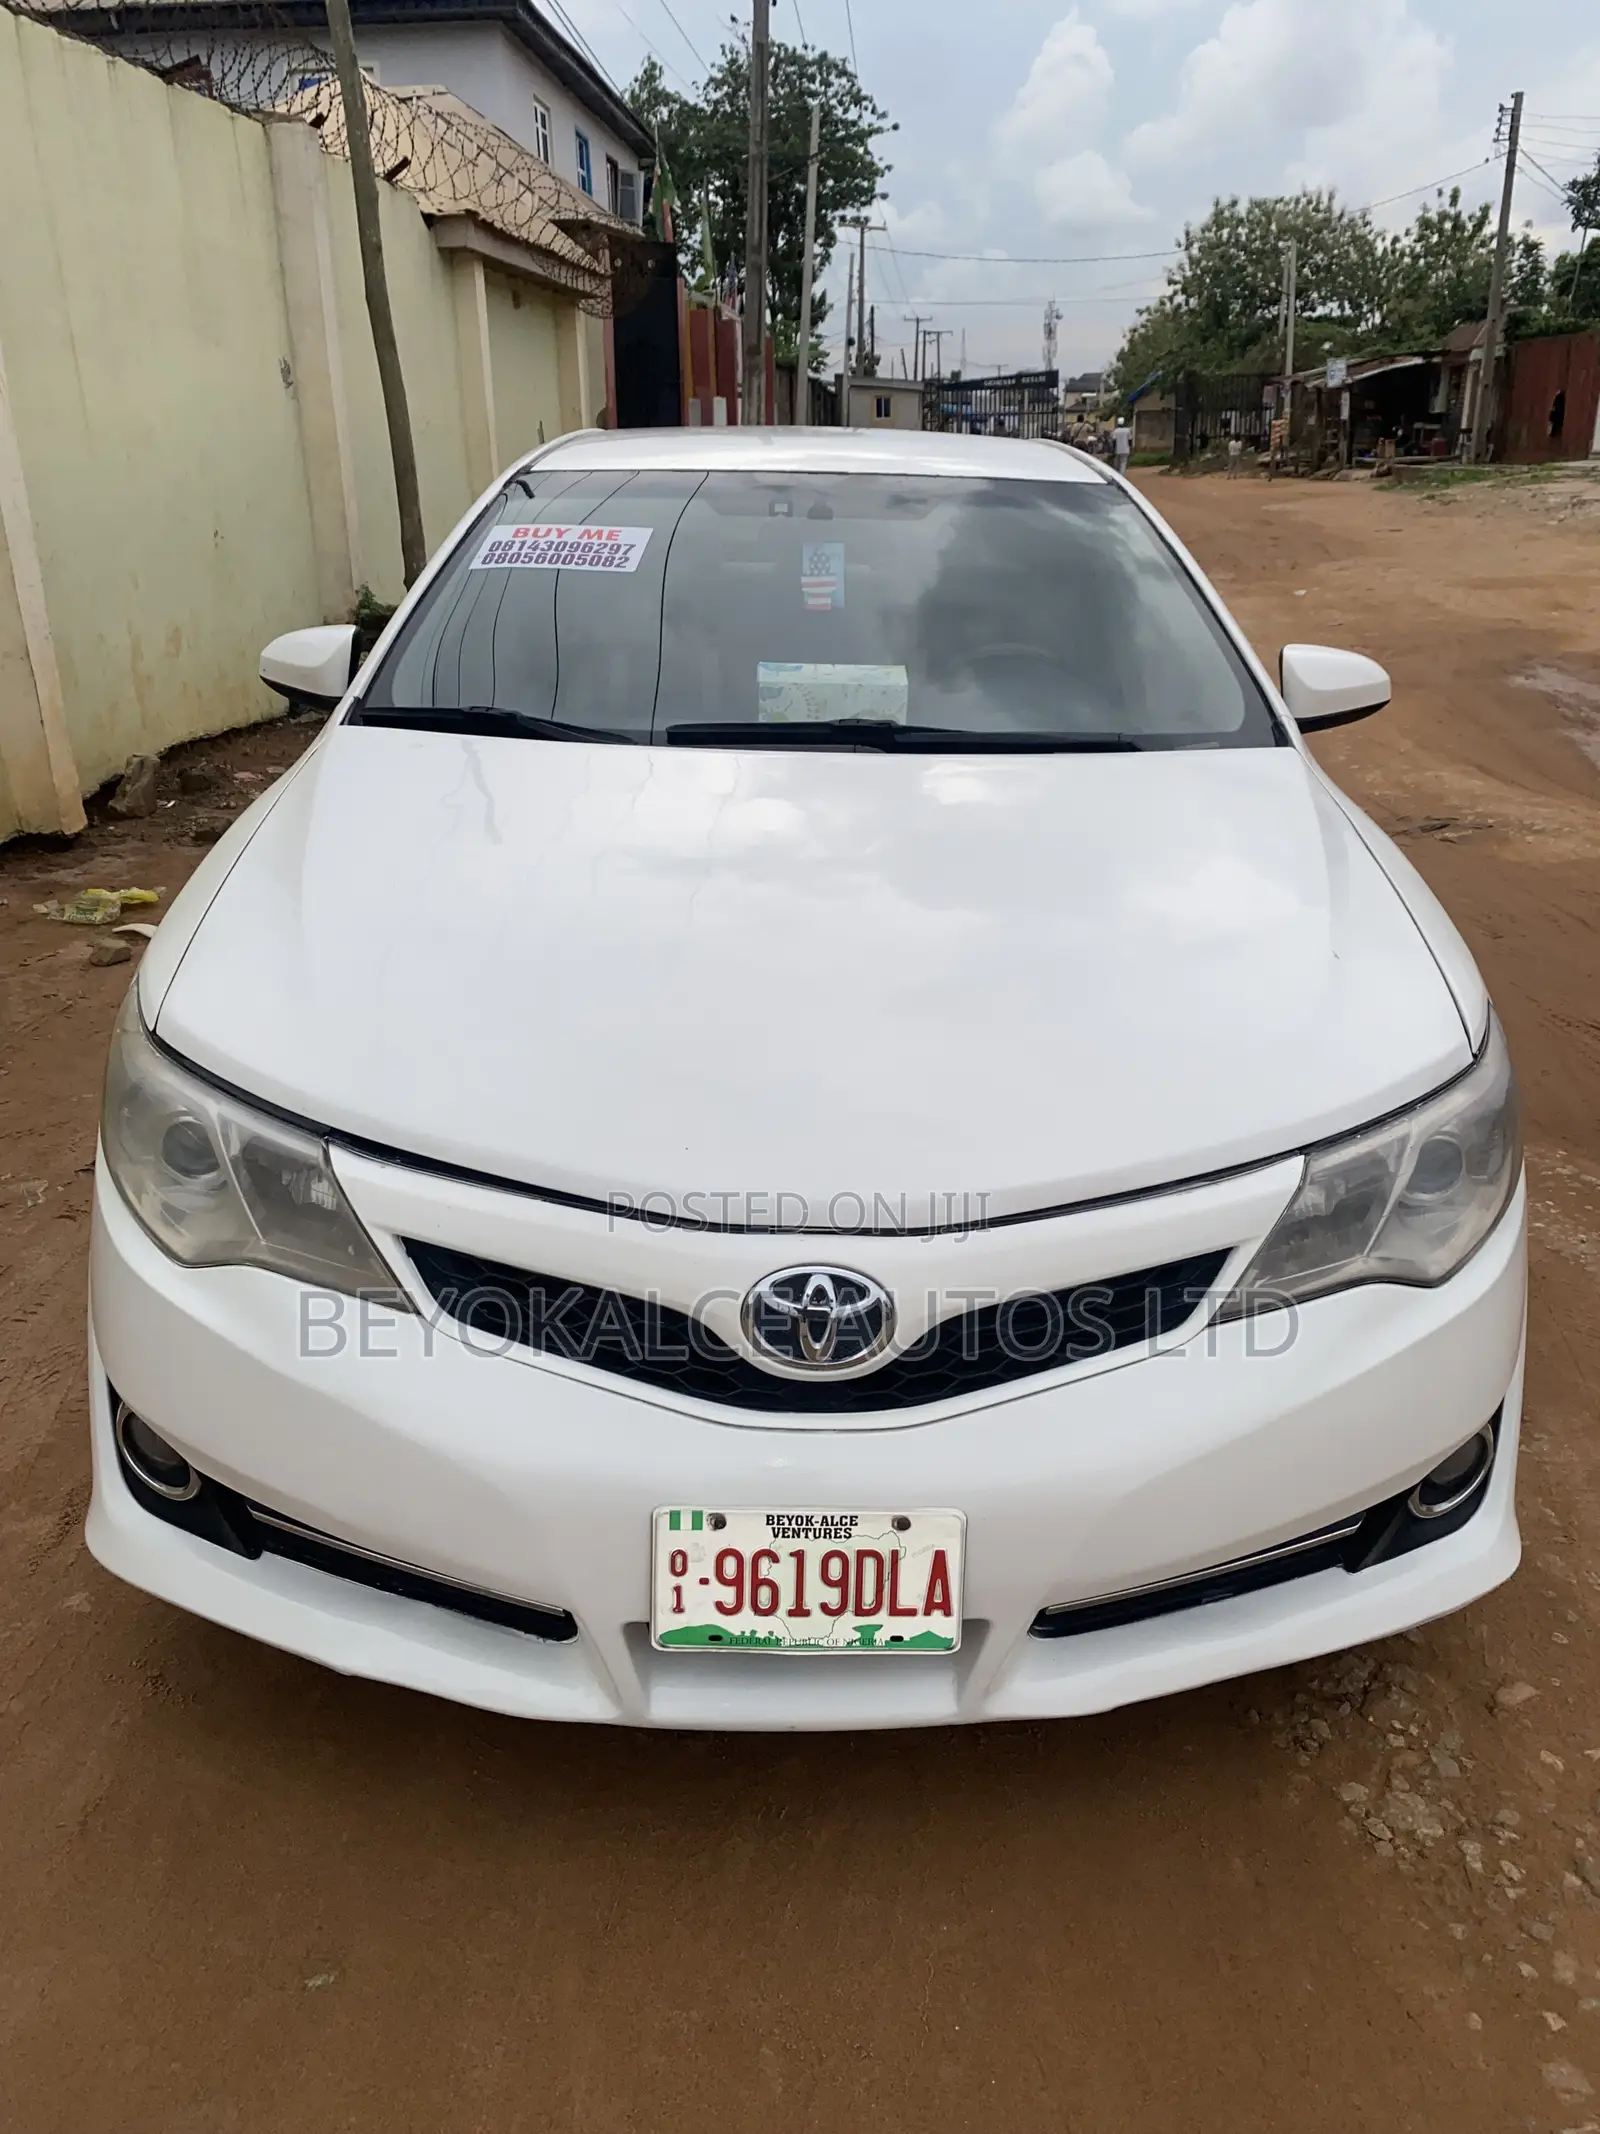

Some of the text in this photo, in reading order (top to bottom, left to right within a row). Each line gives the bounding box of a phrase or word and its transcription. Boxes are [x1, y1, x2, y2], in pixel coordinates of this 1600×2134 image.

[512, 527, 622, 541] BUY ME
[488, 540, 636, 555] 08143096297
[481, 552, 630, 569] 08056005082
[765, 1514, 859, 1527] BEYOK-ALCE
[771, 1527, 852, 1540] VENTURES
[729, 1637, 886, 1646] FEDERAL REPUBLIC OF NIGERIA
